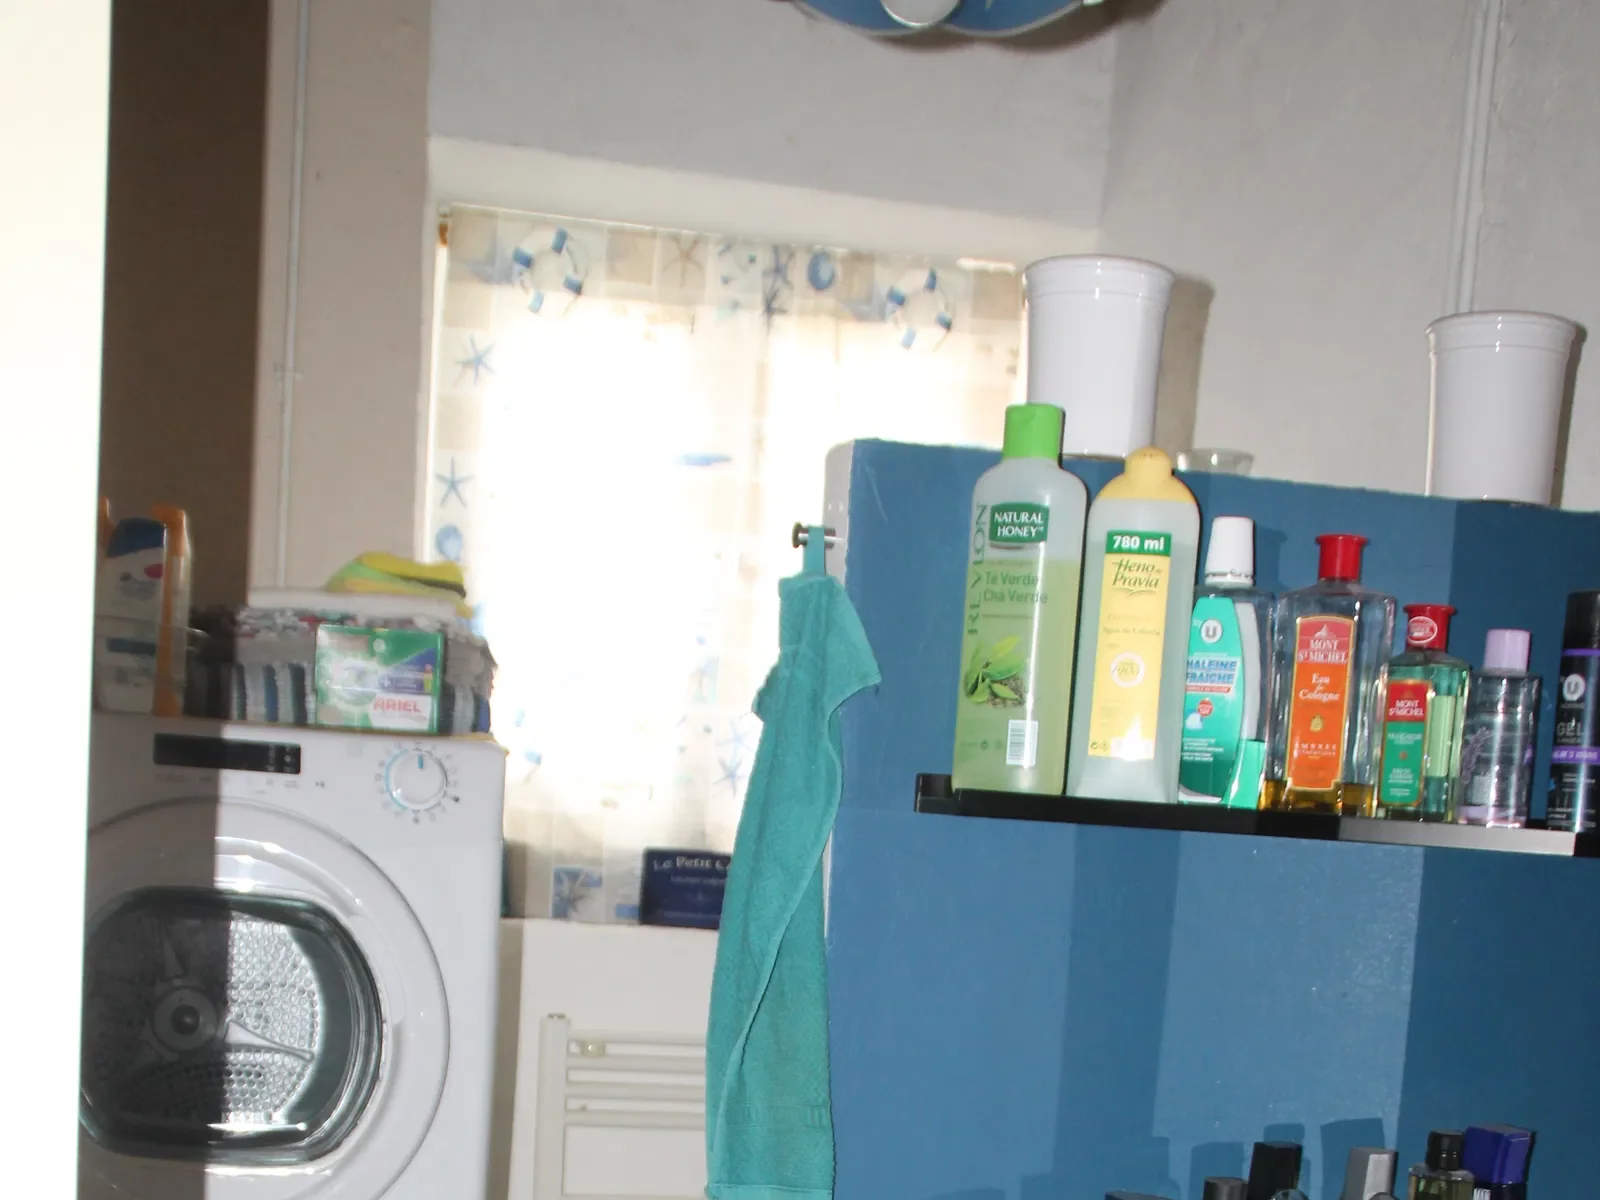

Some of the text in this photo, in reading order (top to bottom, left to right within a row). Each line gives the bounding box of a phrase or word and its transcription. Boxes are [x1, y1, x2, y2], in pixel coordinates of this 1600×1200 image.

[993, 511, 1044, 524] NATURAL
[997, 525, 1037, 538] HONEY
[1112, 535, 1165, 552] 780 ml
[1111, 558, 1156, 573] Heno
[1111, 571, 1160, 588] Pravia
[1008, 588, 1048, 604] Verde
[1309, 639, 1339, 650] MONT
[1308, 651, 1347, 664] MICHEL
[1311, 673, 1331, 684] Eau
[1298, 689, 1341, 702] Cologne
[374, 697, 422, 713] ARIEL
